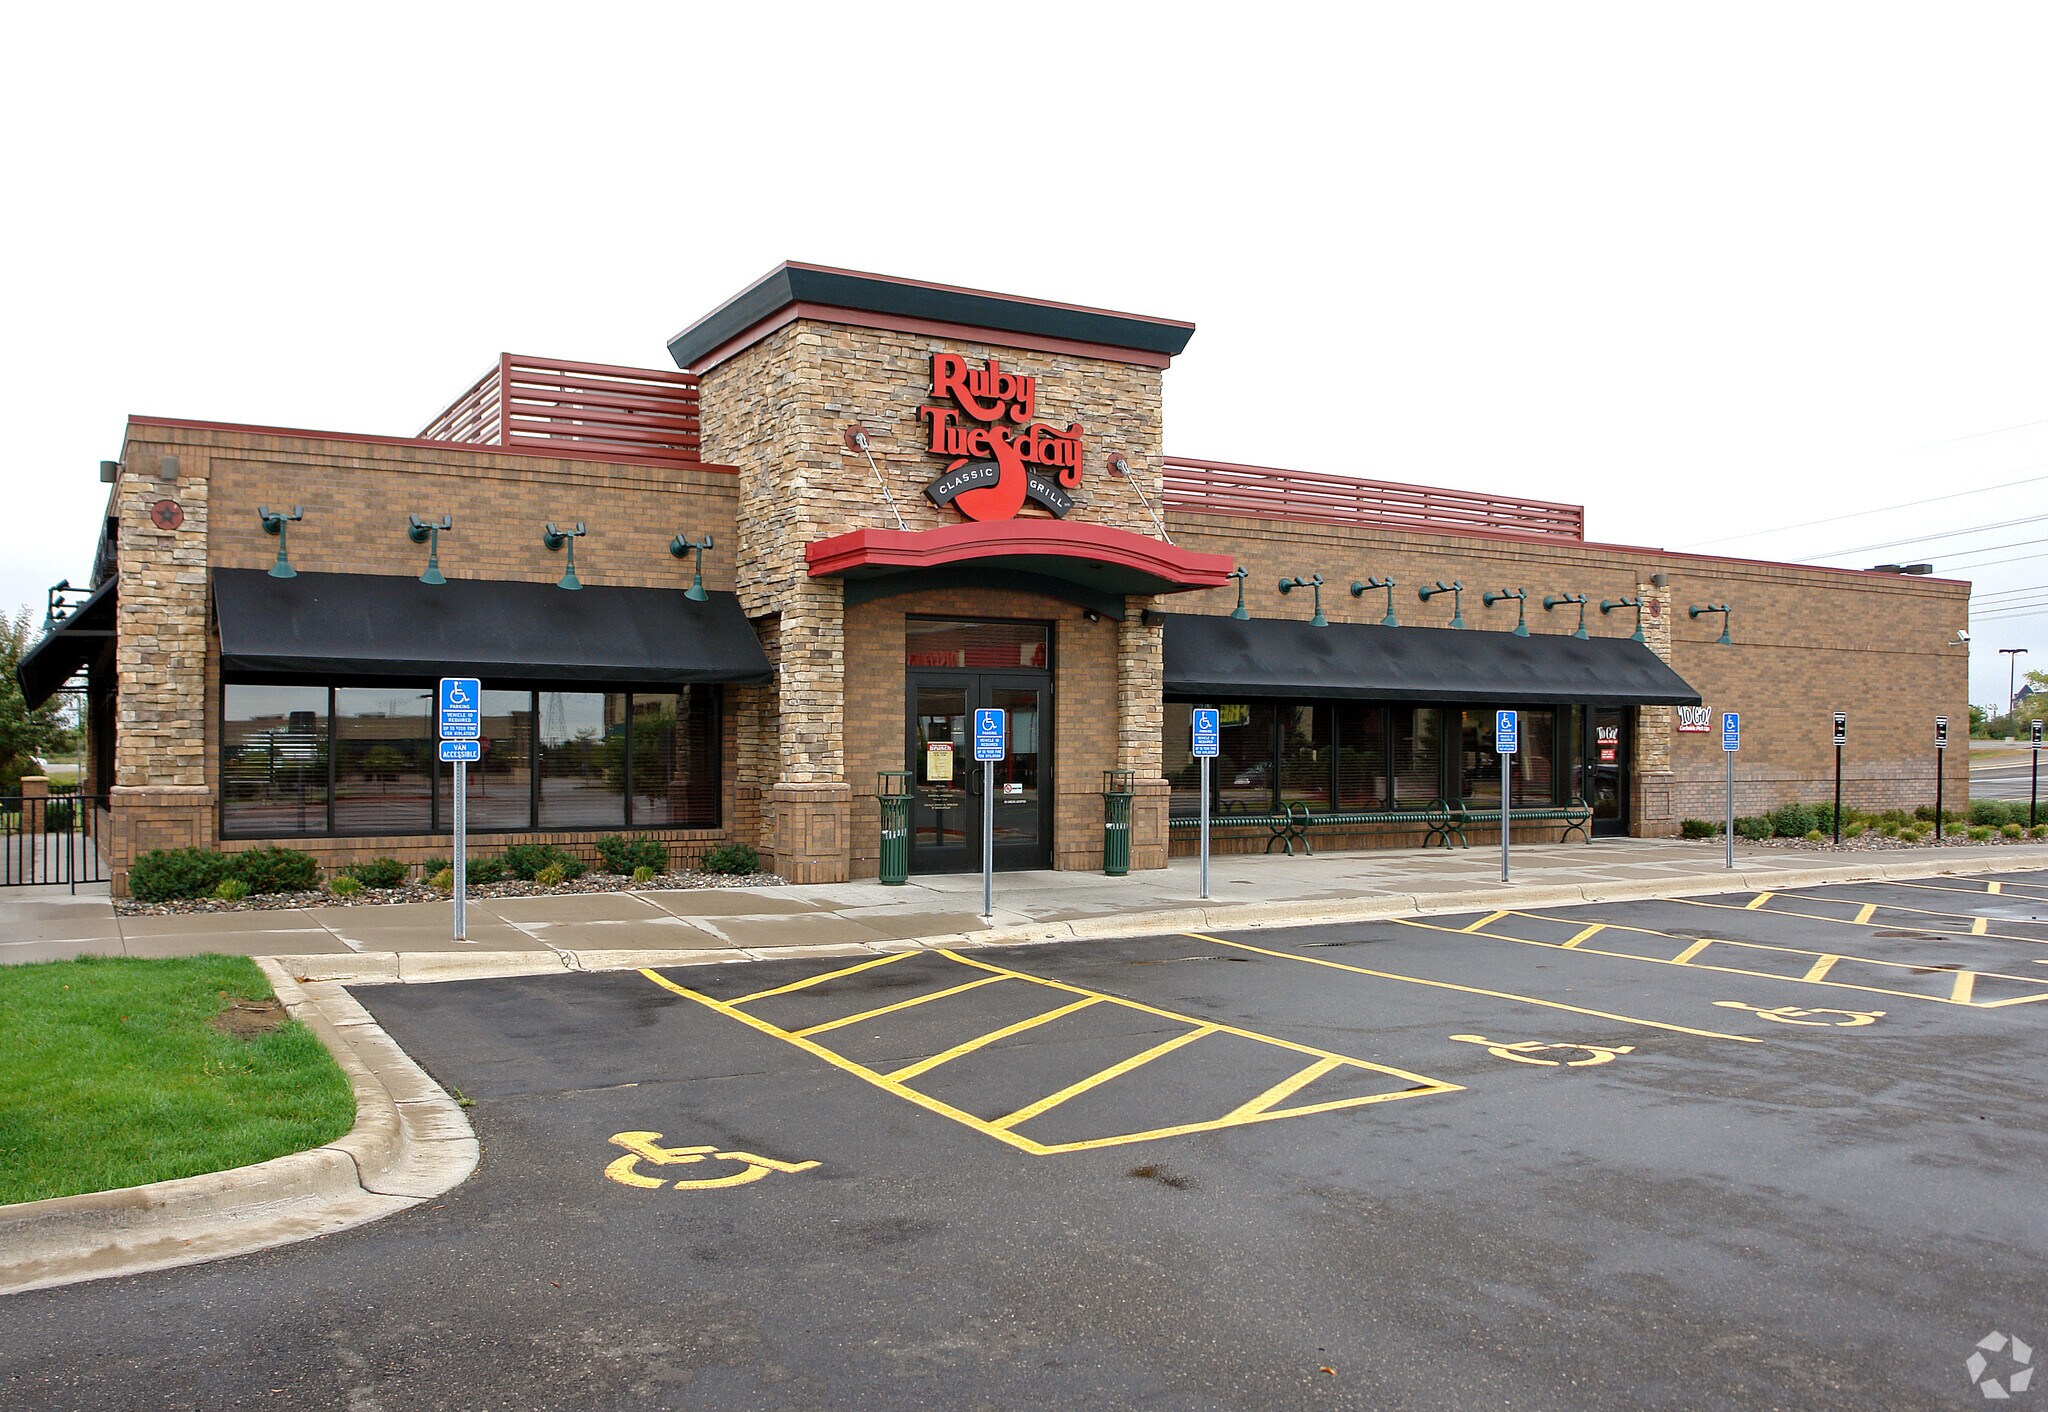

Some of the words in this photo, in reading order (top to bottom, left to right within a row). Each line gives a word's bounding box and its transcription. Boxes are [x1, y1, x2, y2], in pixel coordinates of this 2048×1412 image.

[930, 352, 1035, 424] Ruby
[918, 404, 1084, 522] Tuesday
[939, 468, 993, 494] CLASSIC
[1029, 480, 1063, 507] GRILL
[1677, 705, 1692, 725] To
[1692, 705, 1712, 726] Go!
[1596, 726, 1605, 739] To
[1606, 726, 1618, 739] Go!
